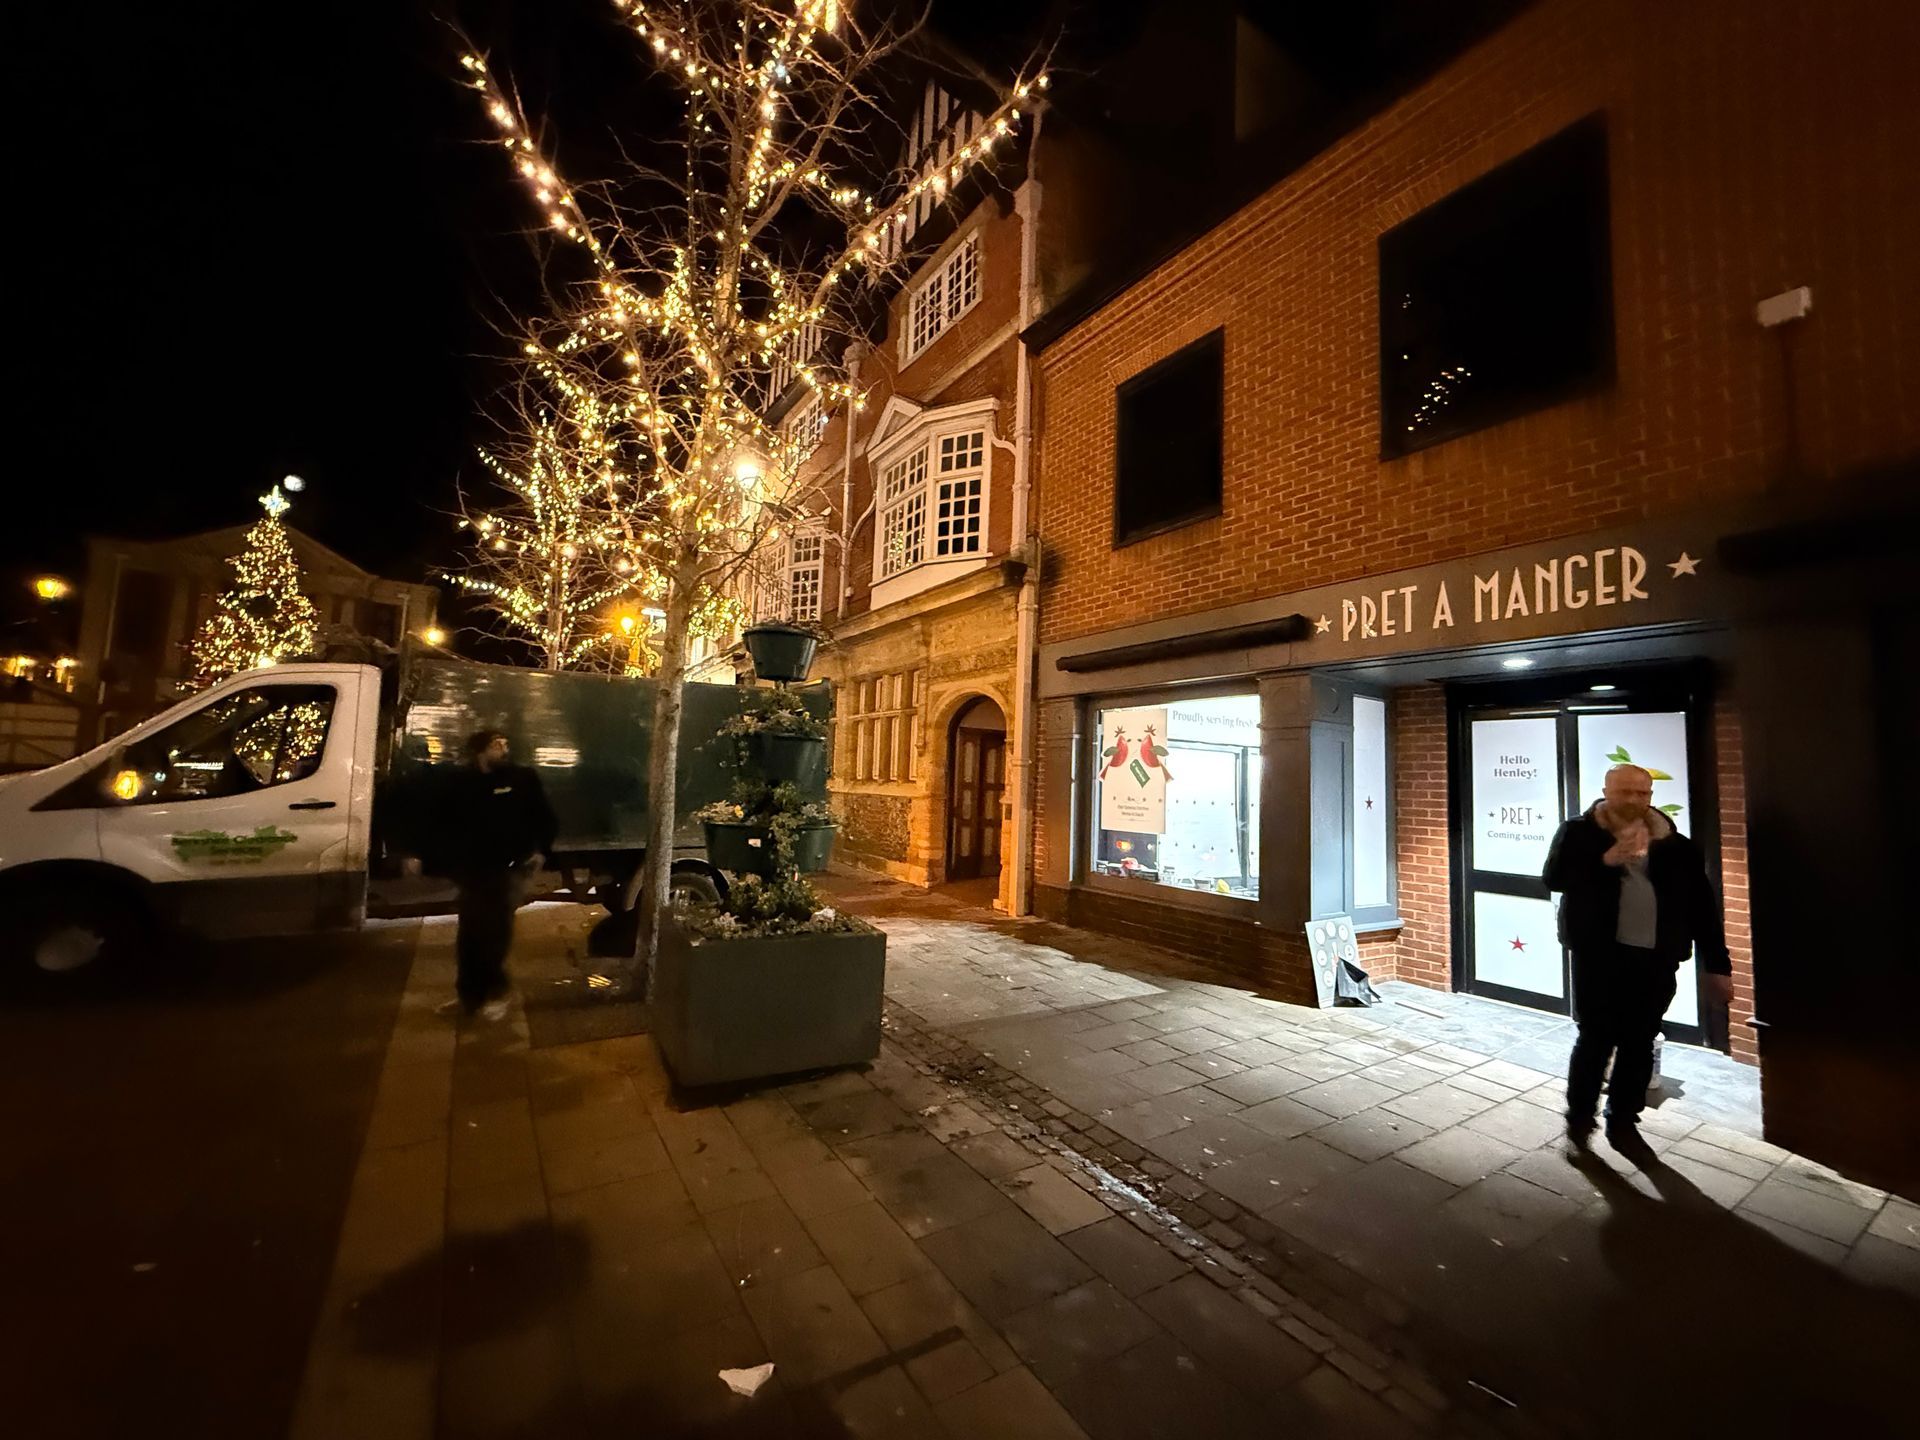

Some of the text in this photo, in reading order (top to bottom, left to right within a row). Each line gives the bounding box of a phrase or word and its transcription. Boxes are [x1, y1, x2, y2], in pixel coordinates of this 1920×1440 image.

[1342, 546, 1649, 642] PRET A MANGER
[1172, 710, 1204, 726] Proudly
[1206, 716, 1235, 728] serving
[1500, 755, 1530, 764] Hello
[1494, 768, 1537, 779] Henley!
[1501, 807, 1532, 825] PRET
[1487, 830, 1521, 841] Coming
